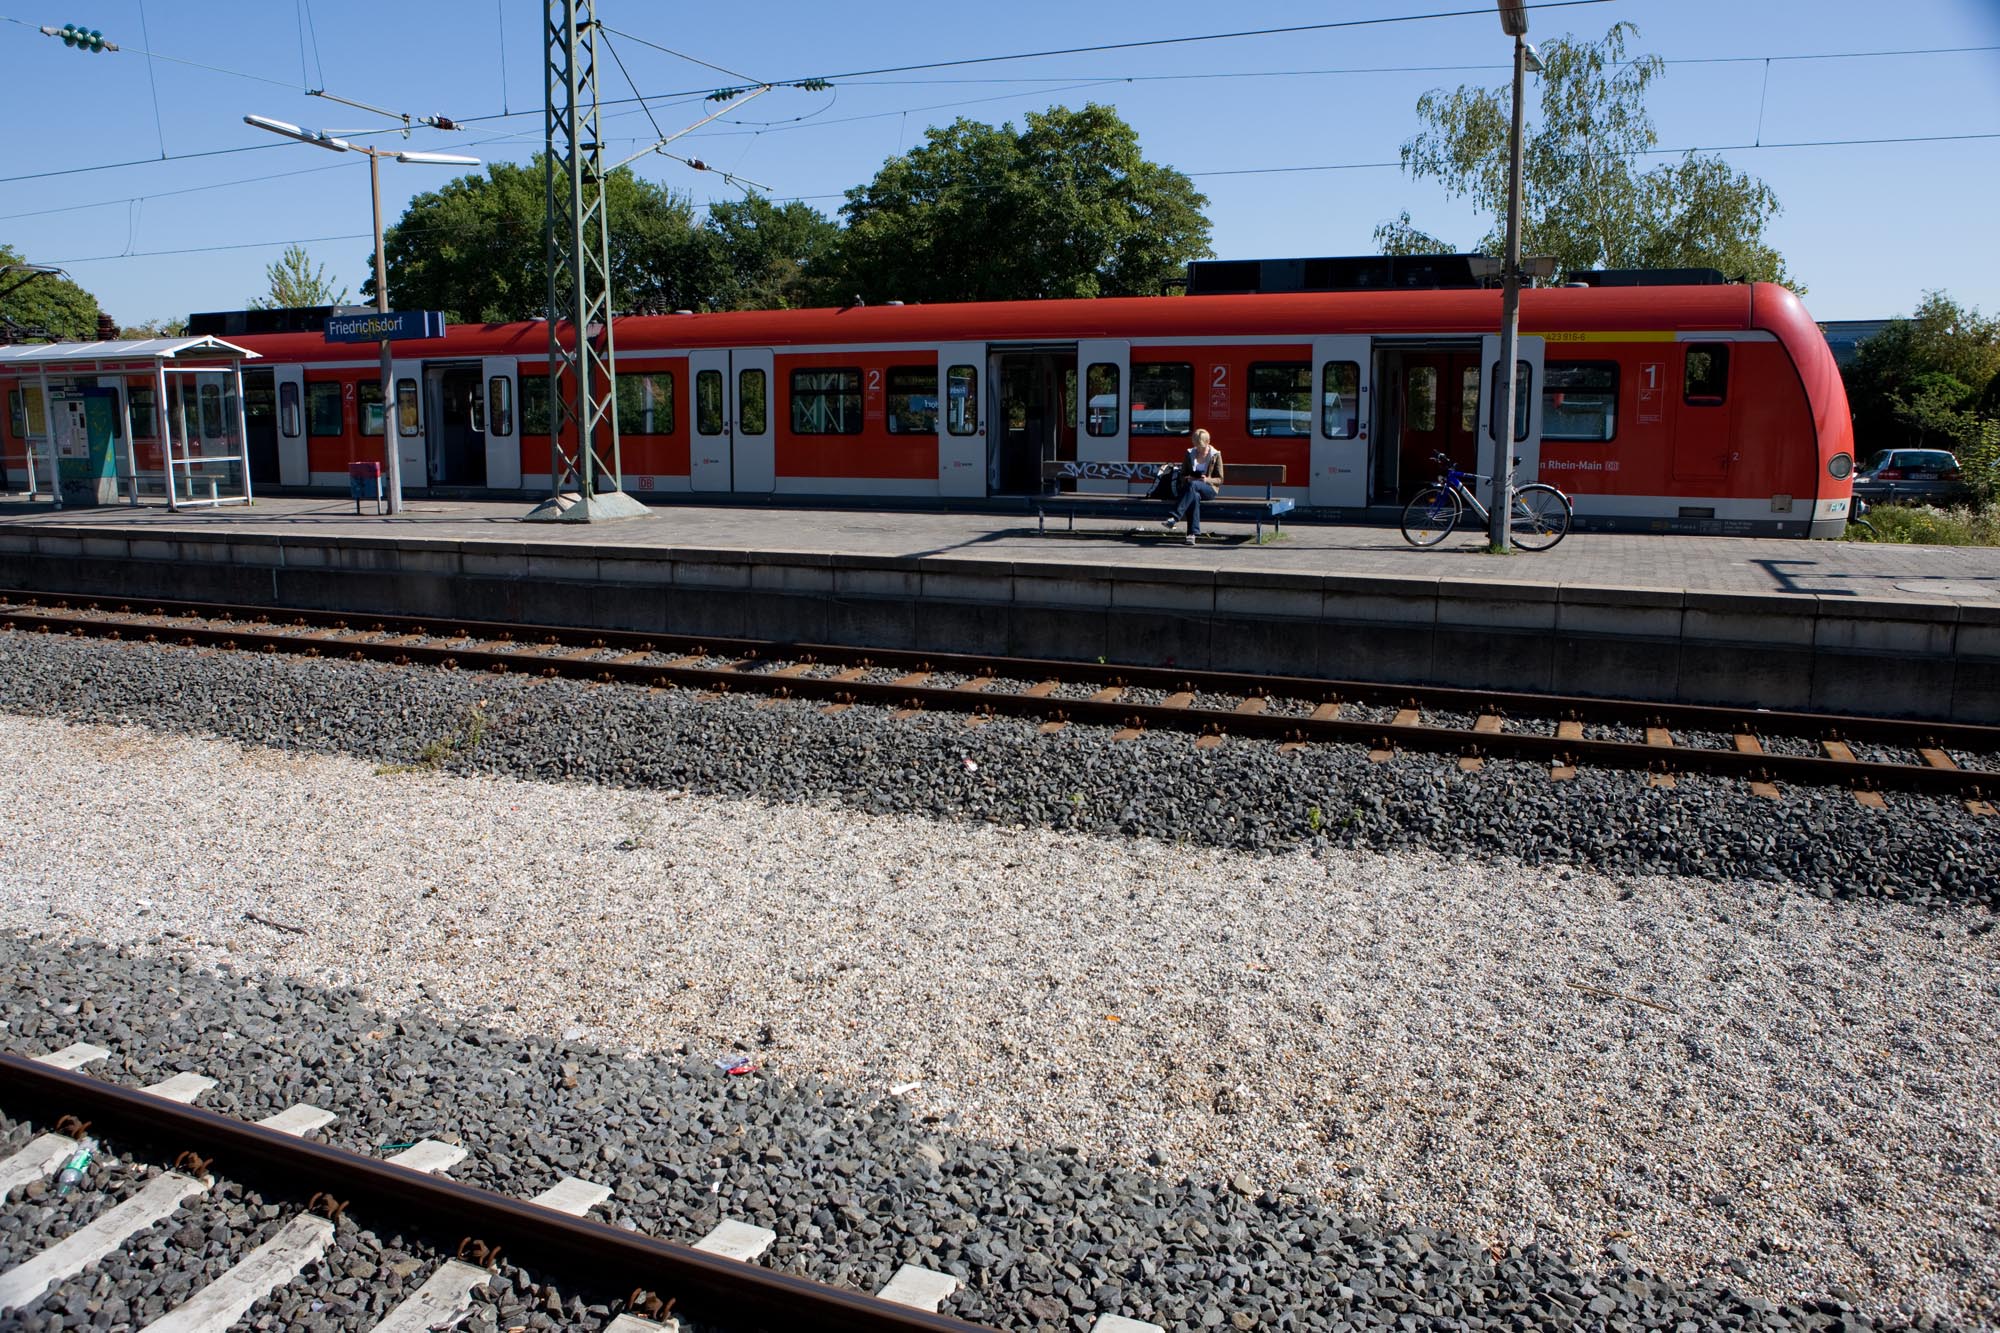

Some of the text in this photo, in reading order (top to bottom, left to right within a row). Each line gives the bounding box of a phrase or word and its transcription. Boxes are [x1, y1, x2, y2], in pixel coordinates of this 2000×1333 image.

[329, 317, 403, 335] Friedrichsdorf
[868, 370, 880, 390] 2
[1212, 366, 1226, 387] 2
[1645, 364, 1656, 388] 1
[345, 383, 354, 400] 2
[1548, 460, 1602, 470] Rhein-Main
[639, 477, 654, 489] DB
